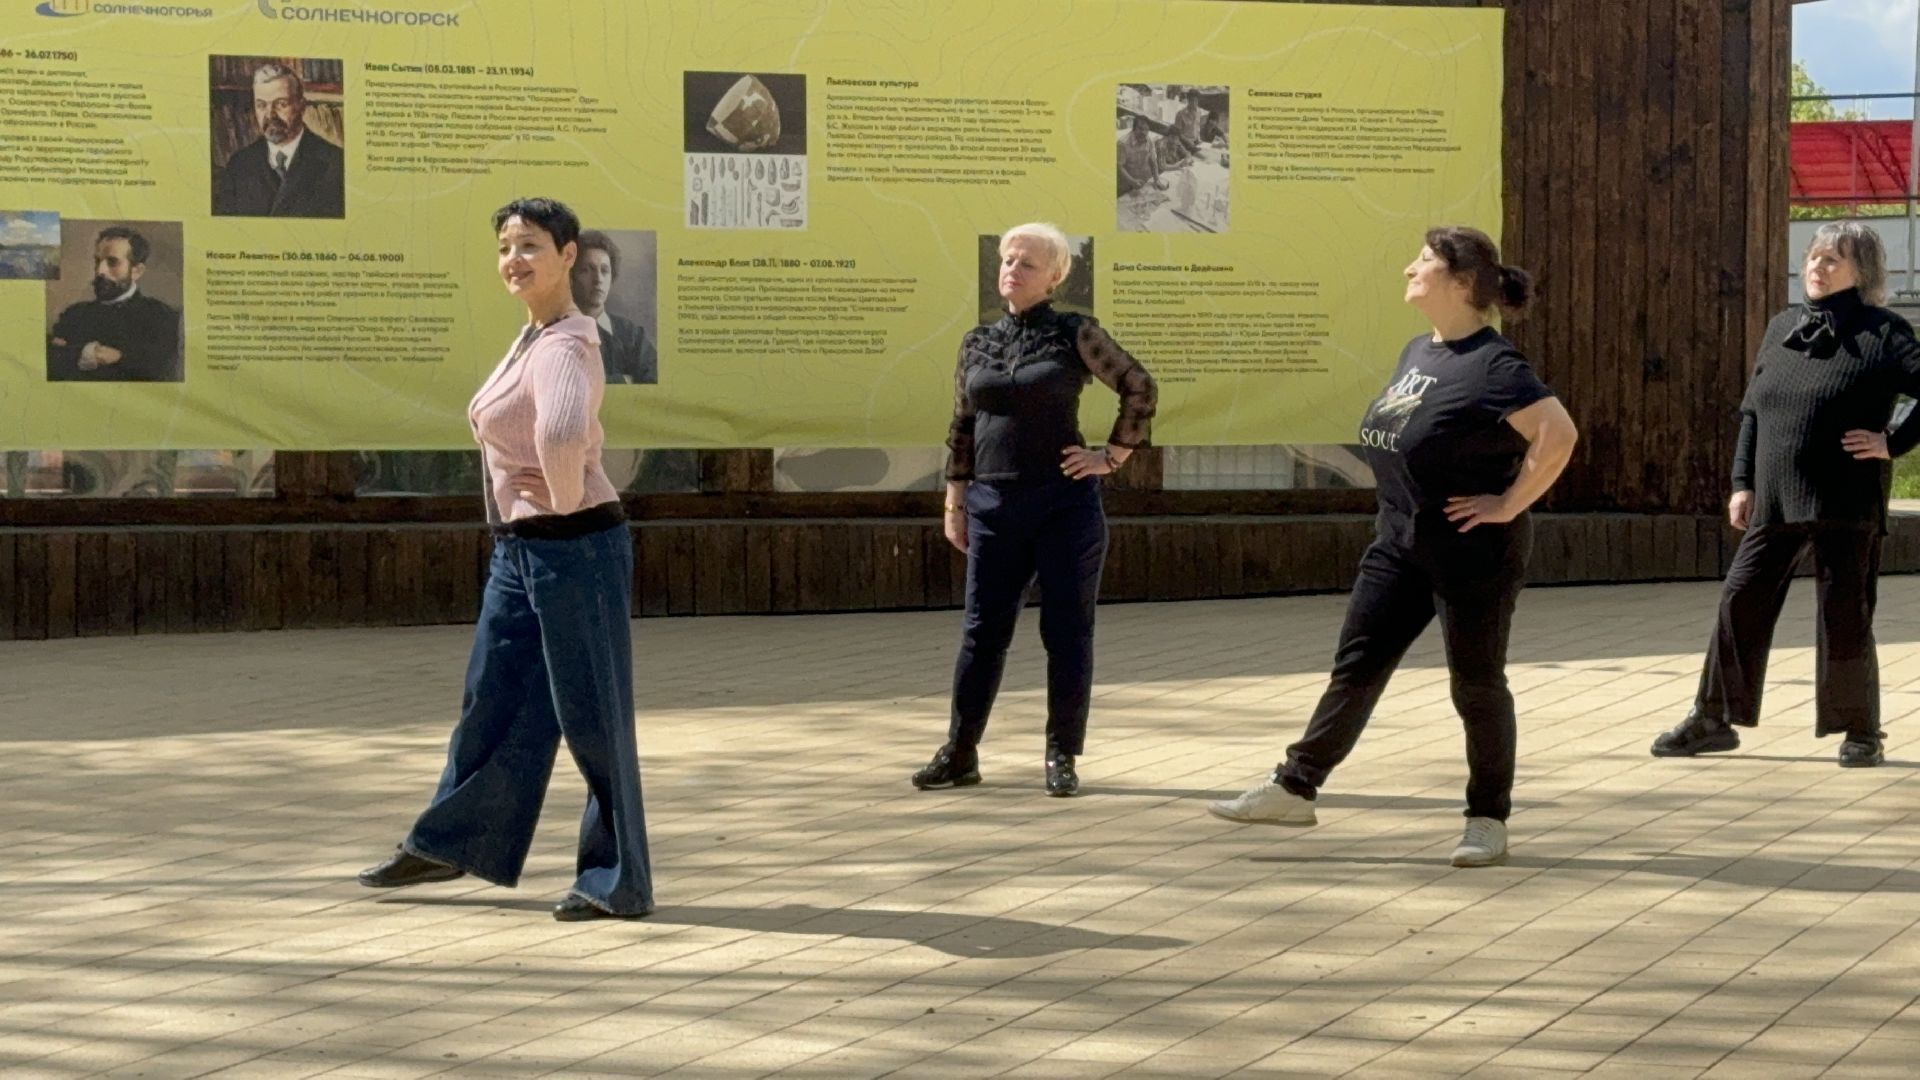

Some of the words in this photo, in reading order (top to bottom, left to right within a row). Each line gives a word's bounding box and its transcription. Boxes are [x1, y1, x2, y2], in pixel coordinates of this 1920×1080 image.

[93, 3, 213, 17] СОЛНЕЧНОГОРЬЯ
[281, 6, 459, 27] СОЛНЕЧНОГОРСК
[1361, 428, 1400, 452] SOUL
